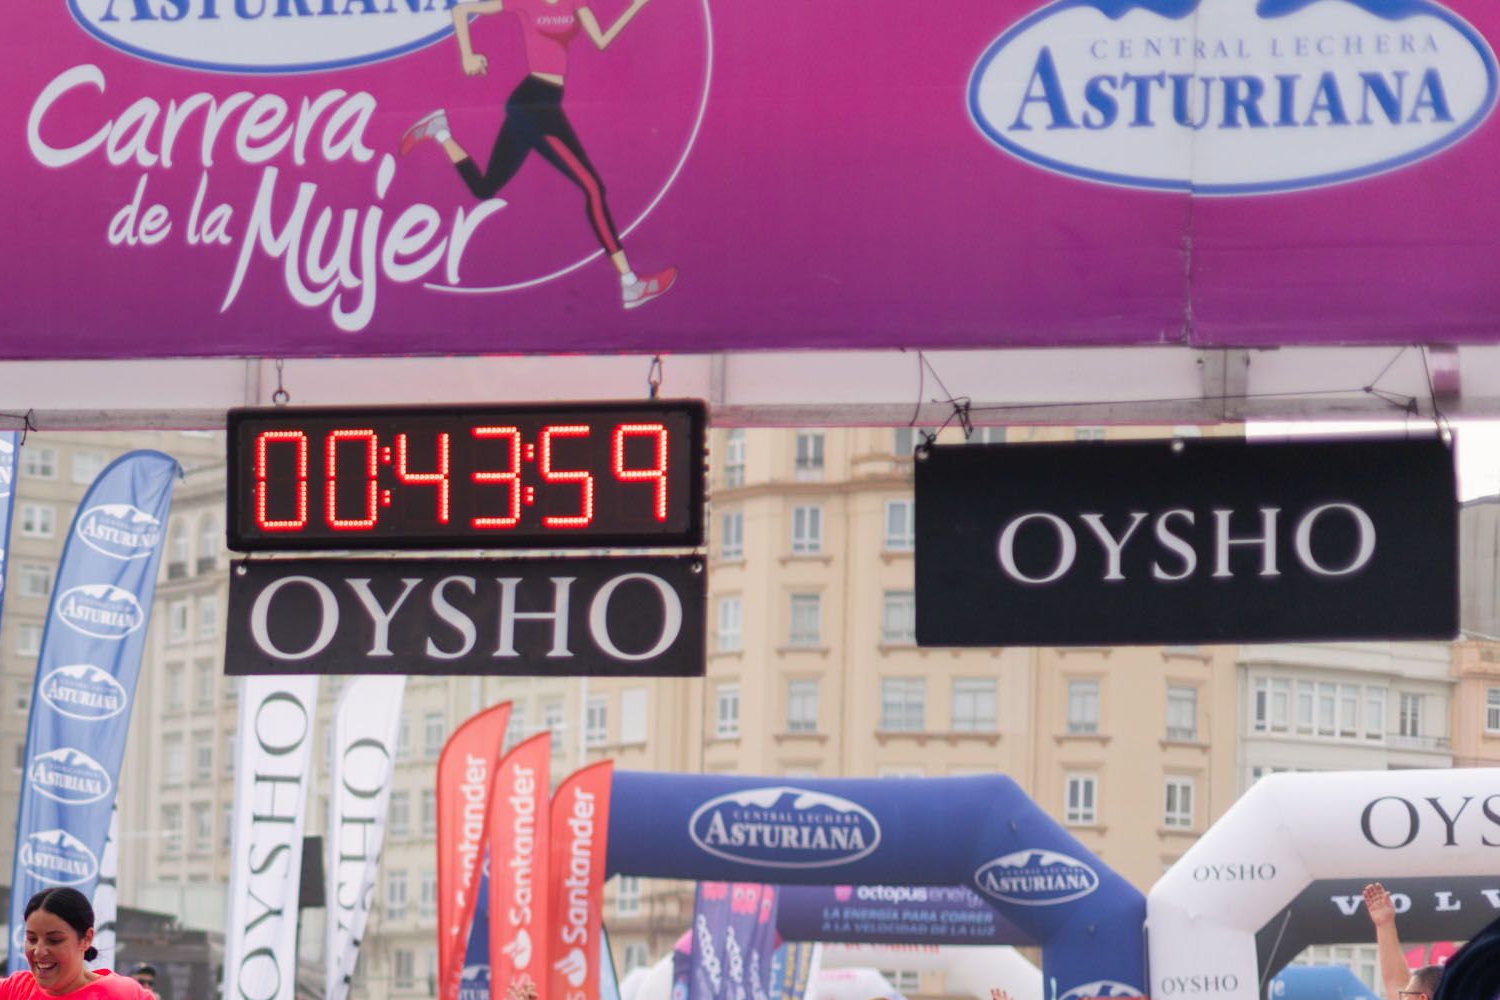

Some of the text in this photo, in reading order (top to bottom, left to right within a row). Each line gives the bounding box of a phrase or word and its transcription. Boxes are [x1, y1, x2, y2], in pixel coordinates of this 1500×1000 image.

[1091, 33, 1440, 60] CENTRAL LECHERA
[27, 63, 376, 168] Carrera
[1007, 45, 1455, 132] ASTURIANA
[108, 169, 234, 245] de la
[220, 153, 508, 332] Mujer
[256, 424, 667, 529] 00:43:59
[999, 503, 1376, 583] OYSHO
[250, 572, 683, 661] OYSHO
[509, 764, 535, 927] Santander
[705, 810, 866, 850] ASTURIANA
[733, 810, 860, 825] CENTRAL LECHERA
[563, 787, 595, 946] Santander
[985, 871, 1090, 892] ASTURIANA
[1193, 863, 1276, 882] OYSHO
[1161, 974, 1238, 995] OYSHO
